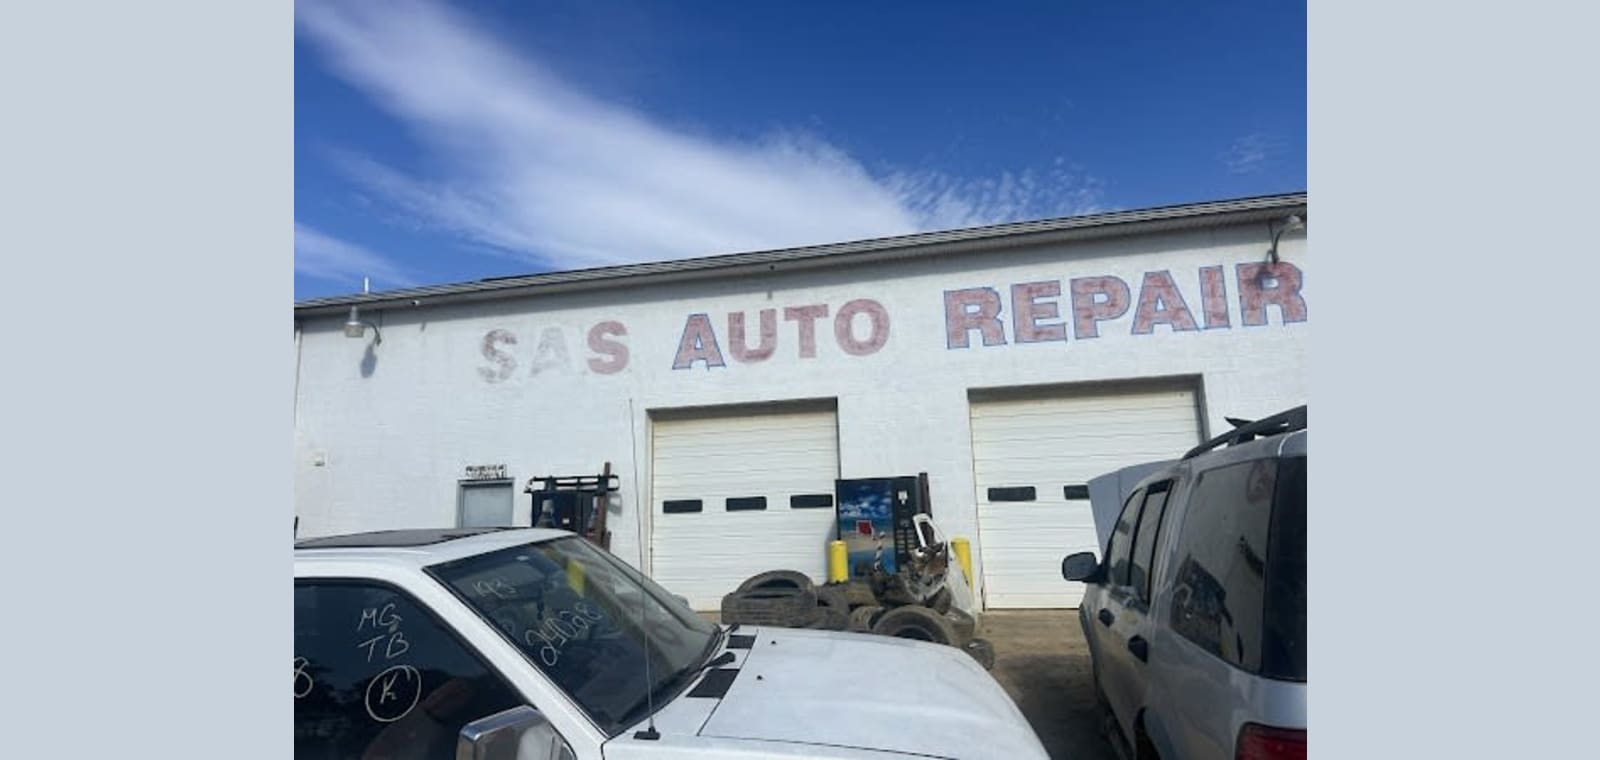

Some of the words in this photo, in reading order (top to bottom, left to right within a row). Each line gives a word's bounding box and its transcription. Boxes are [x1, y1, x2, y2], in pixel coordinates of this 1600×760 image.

[672, 298, 891, 371] AUTO
[943, 260, 1307, 349] REPAIR
[357, 632, 409, 662] TB
